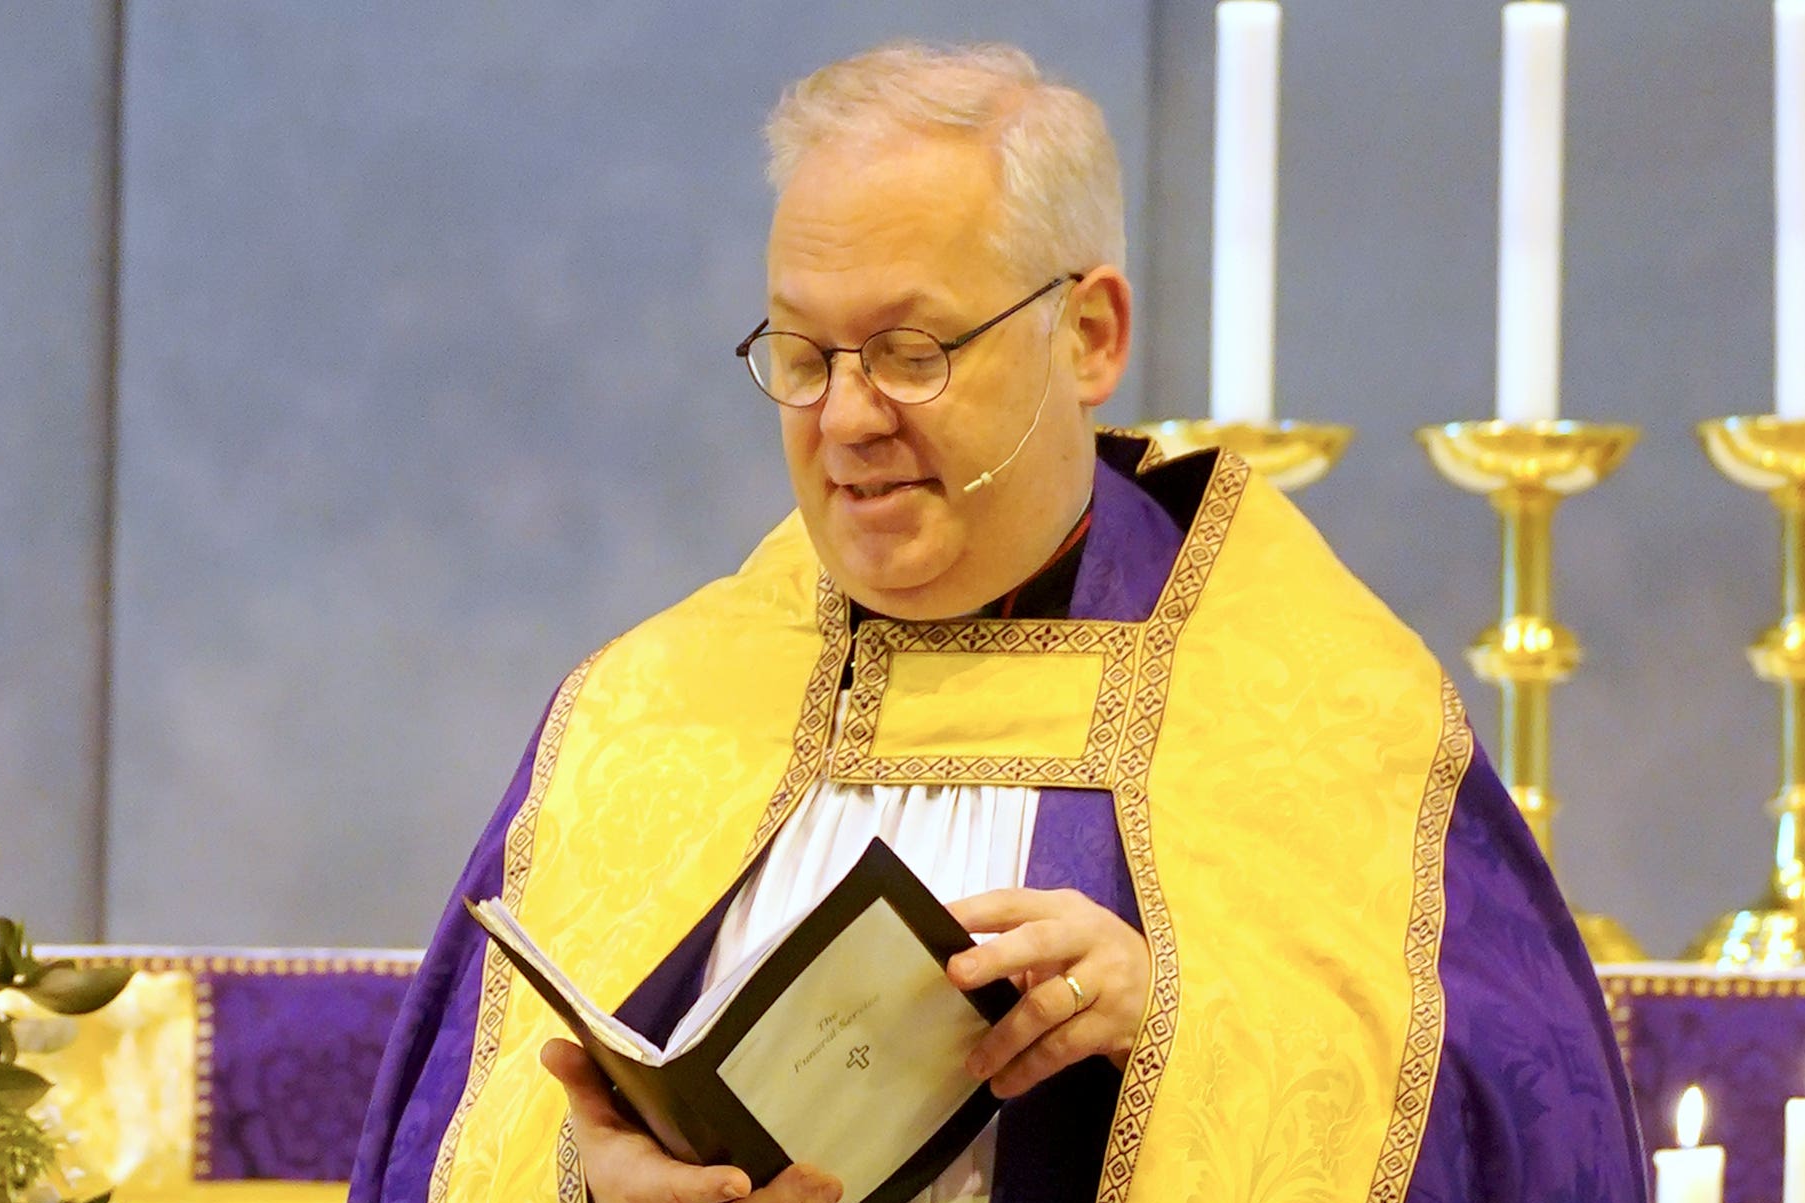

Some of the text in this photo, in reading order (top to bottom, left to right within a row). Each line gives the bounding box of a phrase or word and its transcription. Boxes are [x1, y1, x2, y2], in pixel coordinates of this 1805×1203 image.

[794, 1026, 836, 1073] Funeral
[838, 992, 880, 1031] Service
[816, 1010, 838, 1032] The
